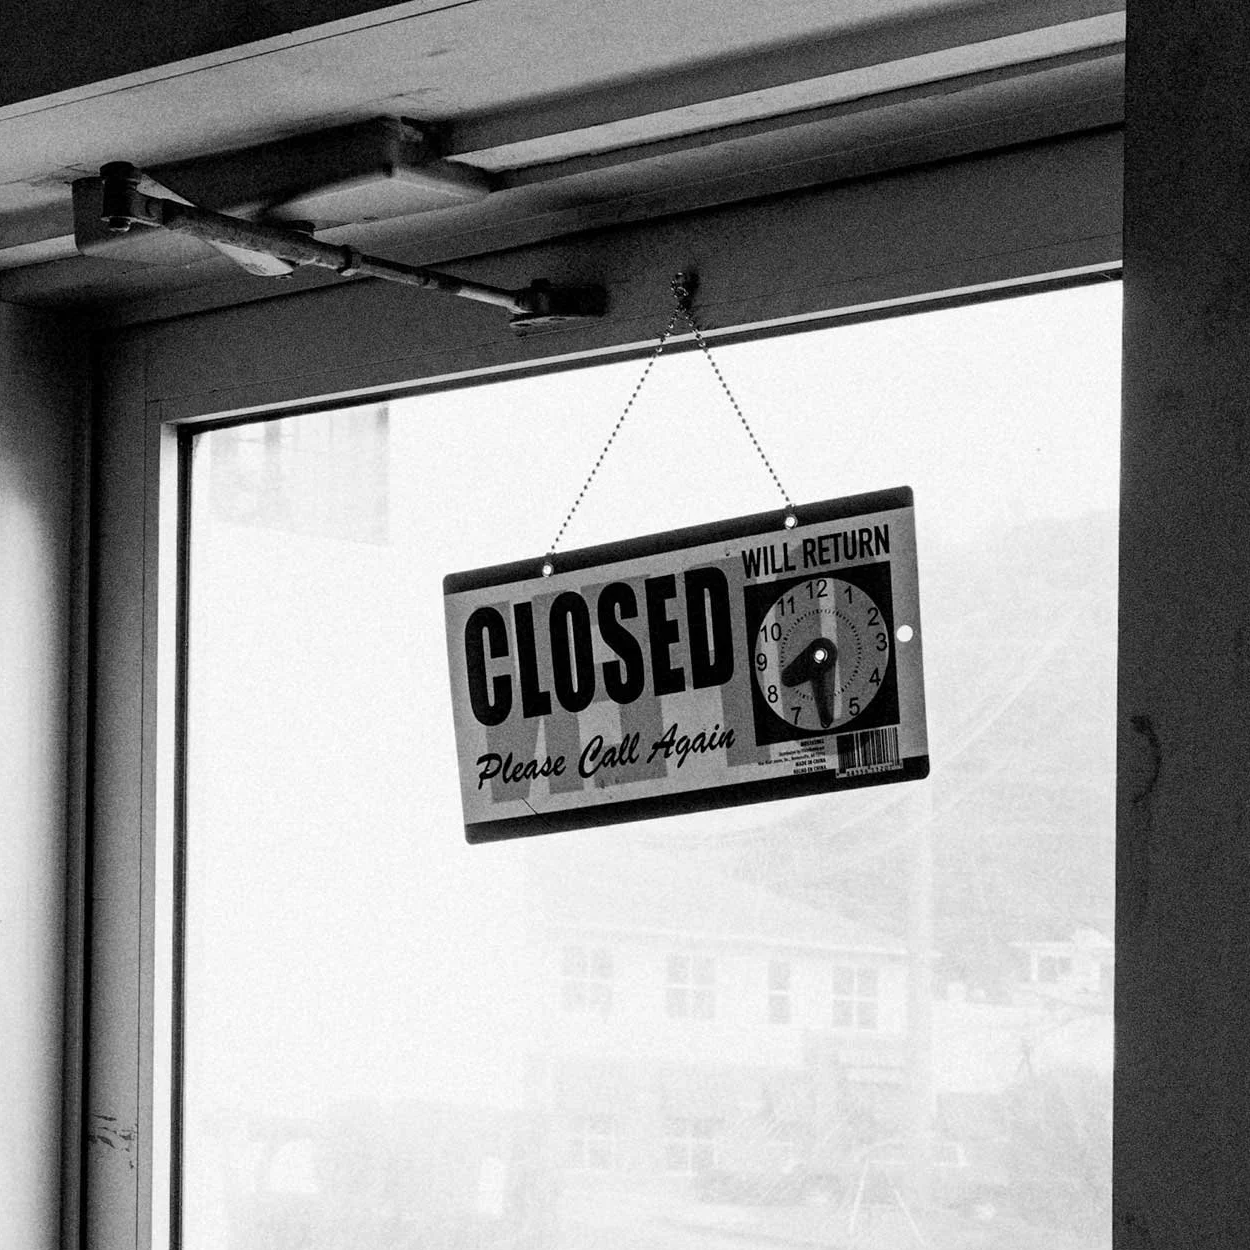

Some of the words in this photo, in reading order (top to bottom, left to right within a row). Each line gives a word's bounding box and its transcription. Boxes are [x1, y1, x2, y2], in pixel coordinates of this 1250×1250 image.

[741, 543, 796, 579] WILL
[803, 524, 890, 564] RETURN
[805, 579, 828, 599] 12
[844, 585, 853, 604] 1
[777, 596, 795, 616] 11
[867, 607, 880, 626] 2
[760, 622, 782, 643] 10
[875, 632, 888, 651] 3
[464, 566, 735, 726] CLOSED
[756, 652, 768, 671] 9
[868, 667, 881, 686] 4
[767, 684, 779, 703] 8
[790, 706, 802, 725] 7
[849, 696, 860, 716] 5
[476, 750, 566, 790] Please
[578, 730, 639, 779] Call
[651, 722, 737, 768] Again
